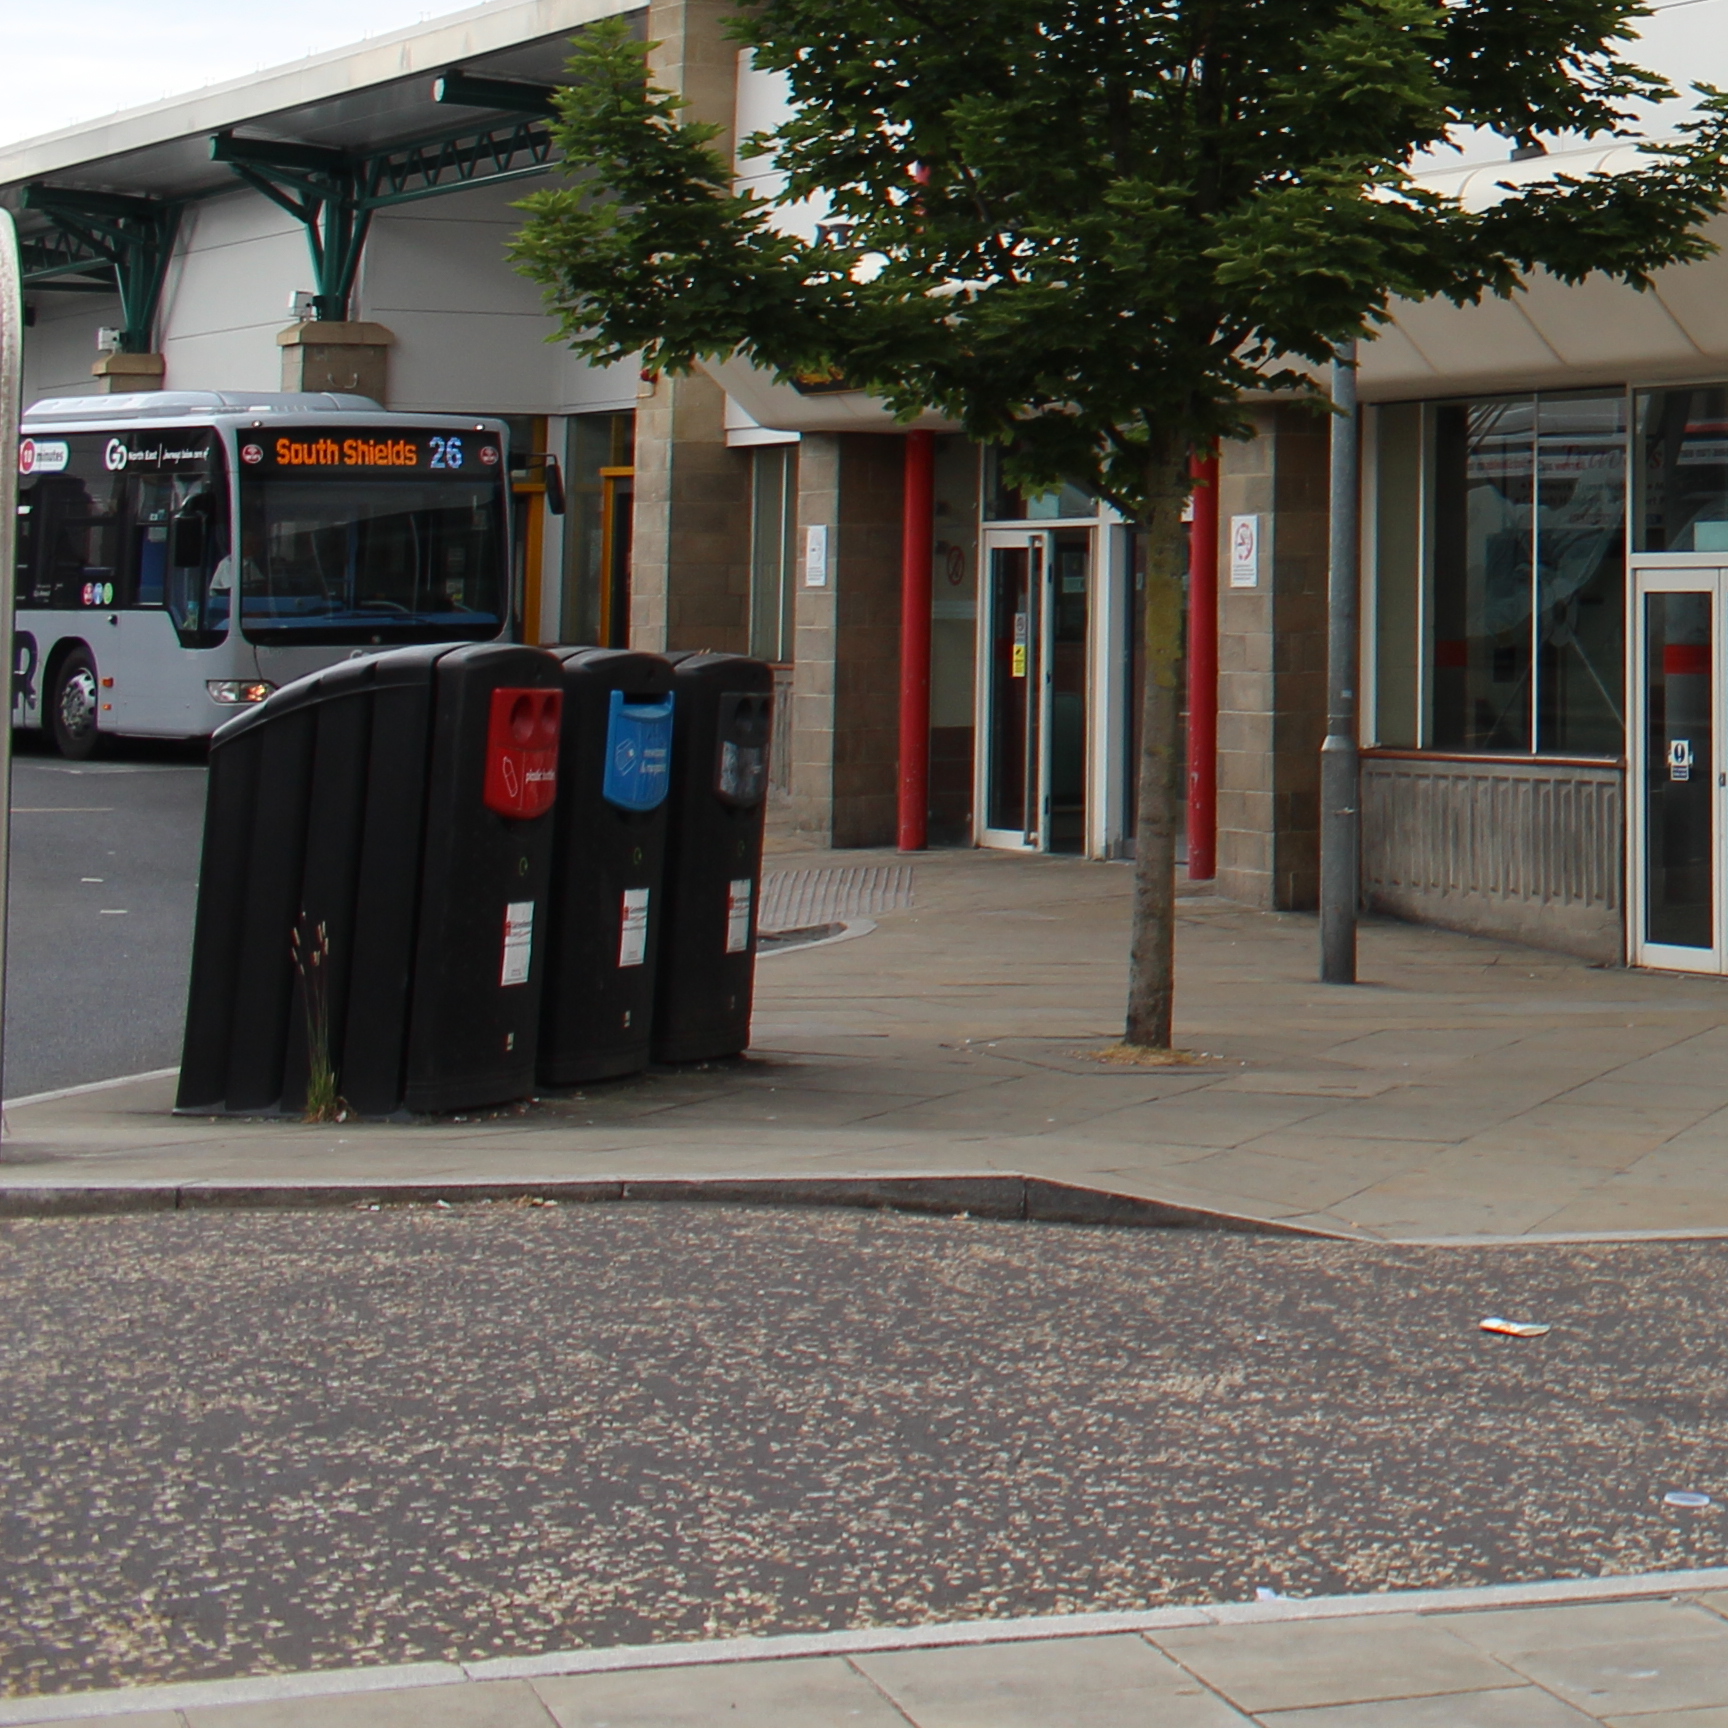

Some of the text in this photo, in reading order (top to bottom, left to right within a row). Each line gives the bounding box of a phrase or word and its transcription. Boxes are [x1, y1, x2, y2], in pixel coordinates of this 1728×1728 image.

[276, 436, 462, 469] South Shields 26
